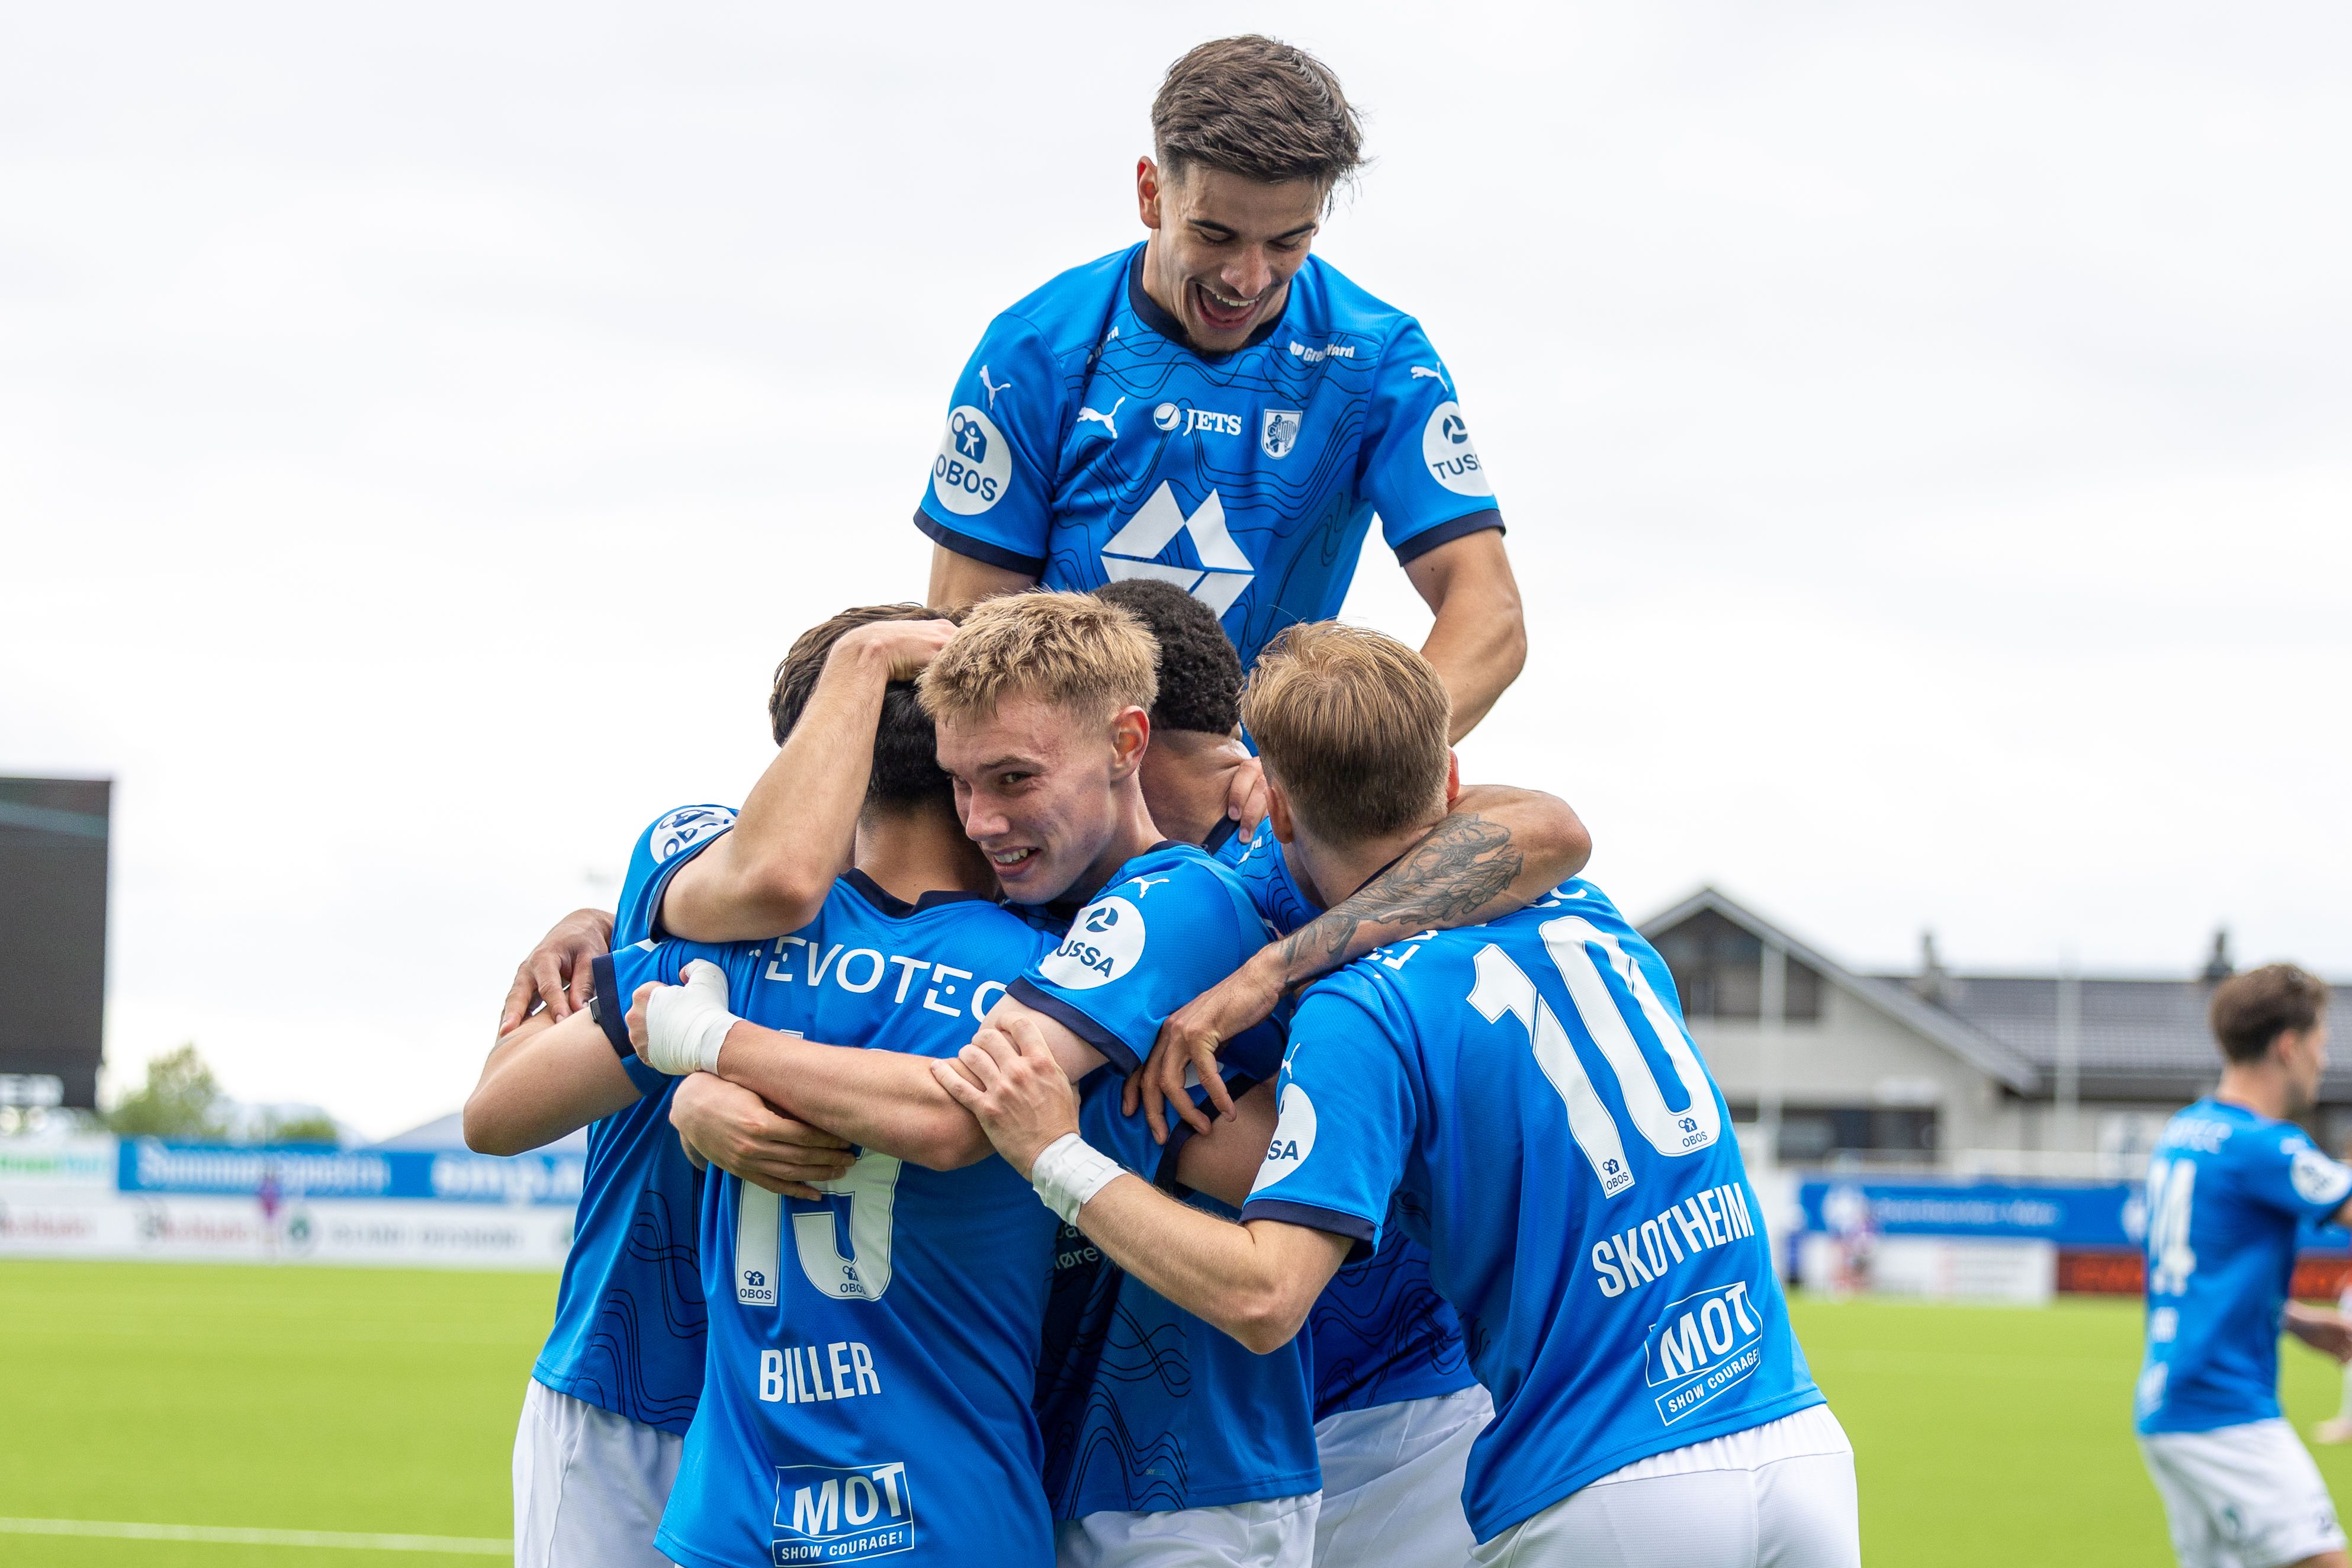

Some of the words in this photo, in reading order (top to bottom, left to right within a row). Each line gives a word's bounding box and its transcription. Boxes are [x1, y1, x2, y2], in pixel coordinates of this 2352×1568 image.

[1183, 409, 1242, 436] JETS
[936, 454, 998, 502] OBOS
[1426, 454, 1483, 480] TUS
[1049, 940, 1114, 978] USSA
[1466, 915, 1721, 1199] 10
[1682, 1132, 1707, 1147] OBOS
[1606, 1172, 1629, 1190] OBOS
[1592, 1183, 1755, 1297] SKOTHEIM
[740, 1289, 772, 1299] OBOS
[840, 1283, 866, 1295] OBOS
[1660, 1281, 1756, 1379] MOT
[760, 1342, 881, 1403] BILLER
[1668, 1384, 1705, 1413] SHOW
[793, 1463, 905, 1535] MOT
[782, 1545, 822, 1560] SHOW
[829, 1531, 903, 1556] COURAGE!
